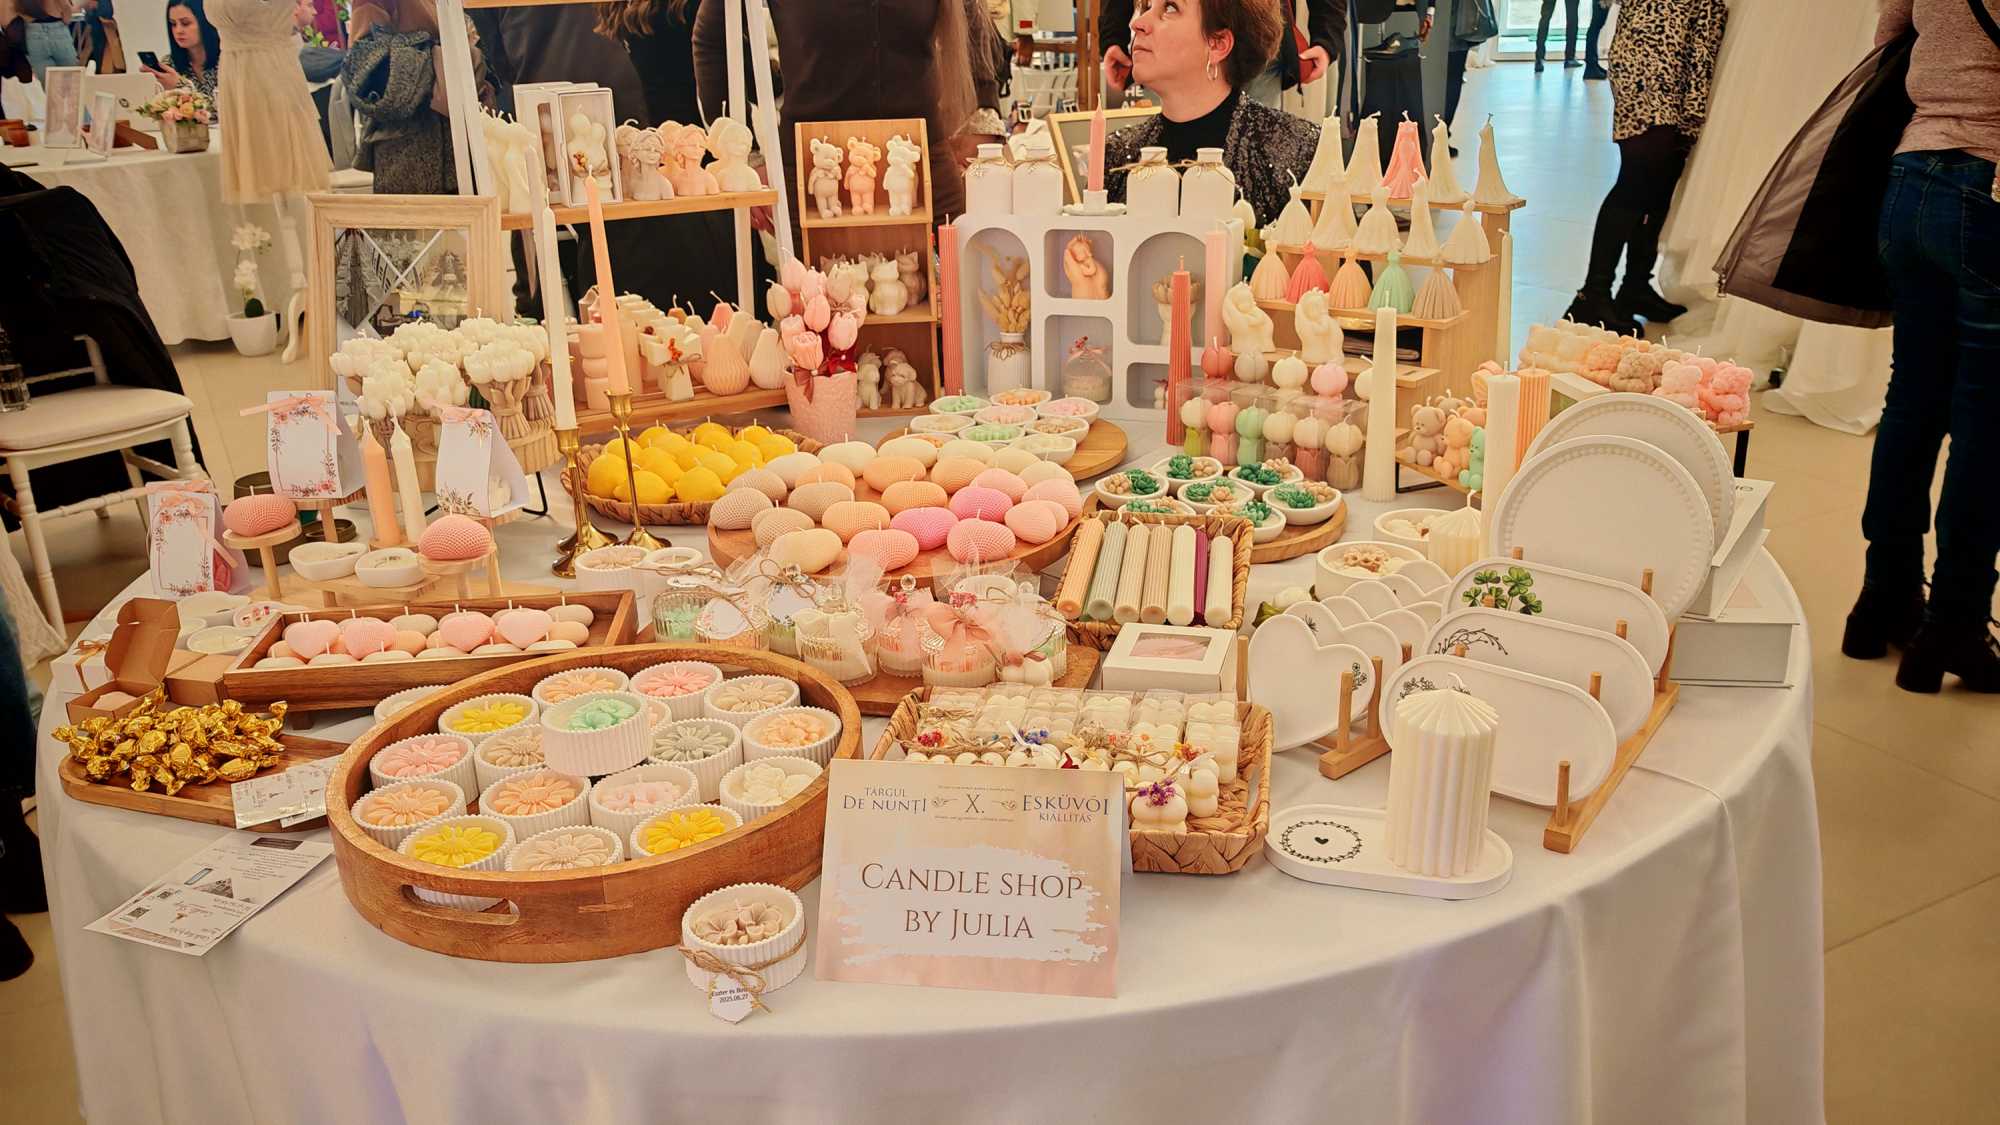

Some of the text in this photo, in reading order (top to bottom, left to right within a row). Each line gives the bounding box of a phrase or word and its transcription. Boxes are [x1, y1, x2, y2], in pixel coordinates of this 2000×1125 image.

[843, 795, 865, 810] DE
[965, 793, 985, 814] X.
[861, 863, 1083, 899] CANDLE SHOP
[904, 908, 1035, 942] BY JULIA
